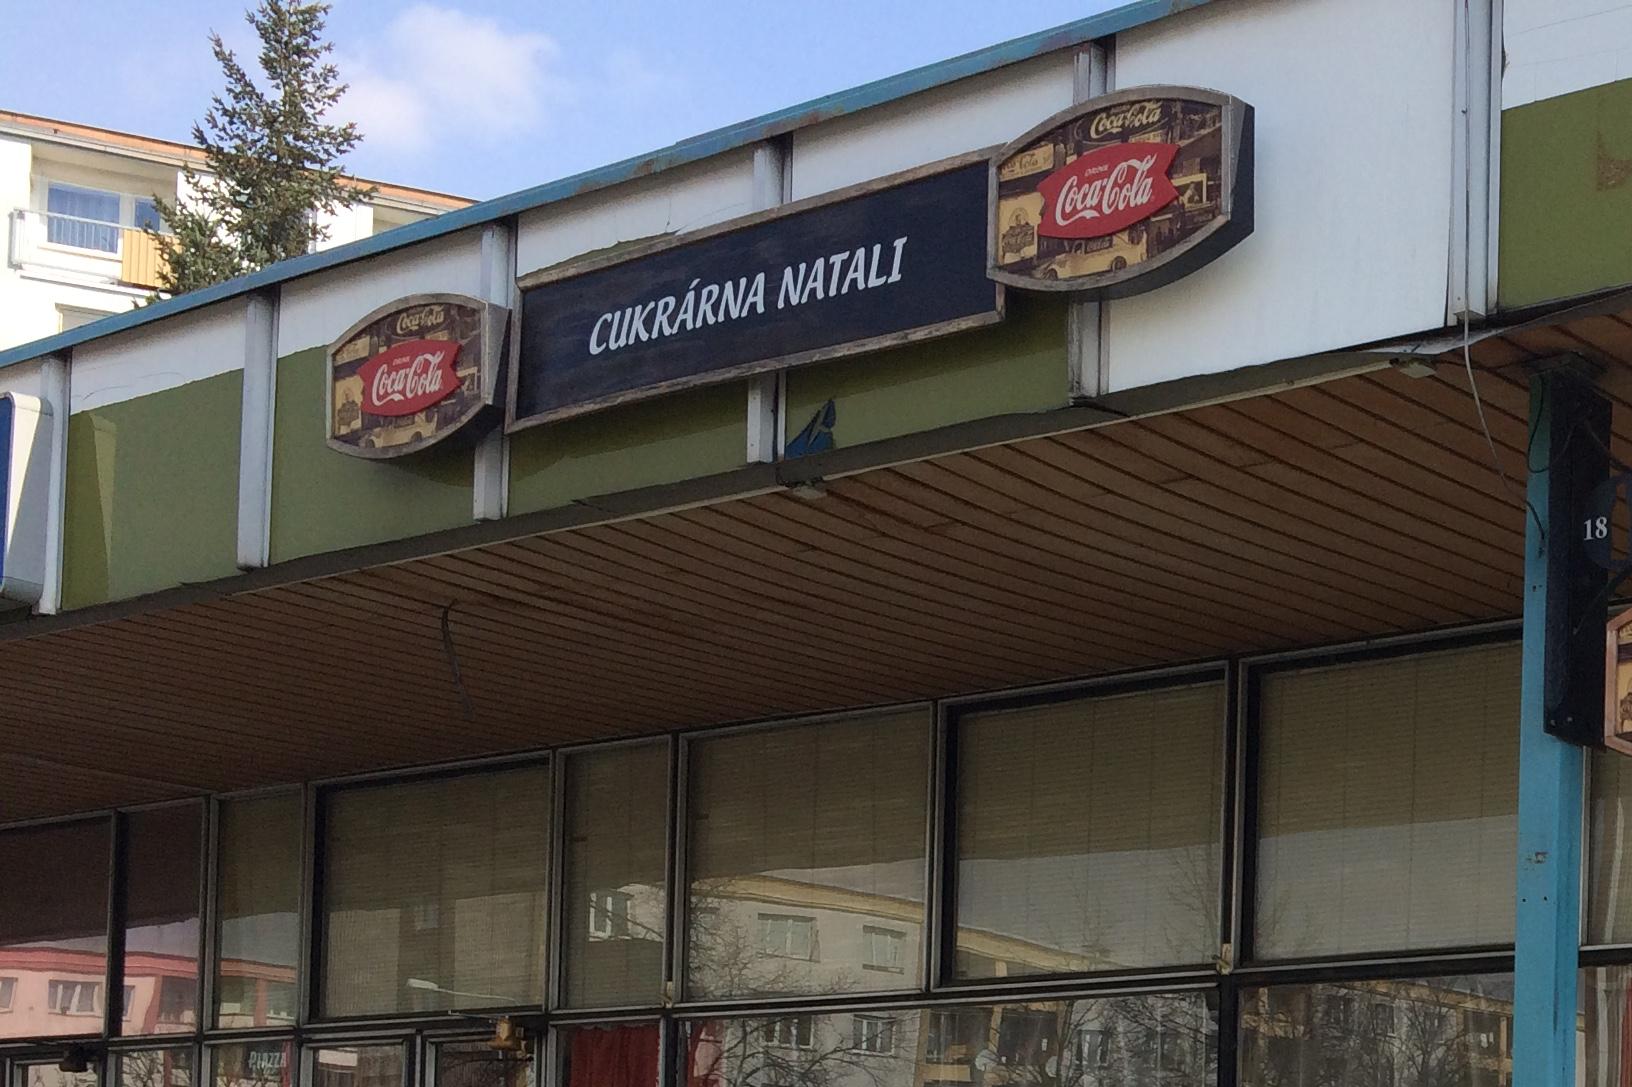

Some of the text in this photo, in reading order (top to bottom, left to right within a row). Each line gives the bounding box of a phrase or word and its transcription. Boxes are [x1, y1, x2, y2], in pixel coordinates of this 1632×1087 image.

[1056, 153, 1157, 226] Coca-Cola
[589, 237, 908, 356] CUKRÁRNA NATALI
[372, 351, 445, 407] Coca-Cola
[1583, 516, 1608, 541] 18
[248, 1051, 287, 1070] PIAZZA
